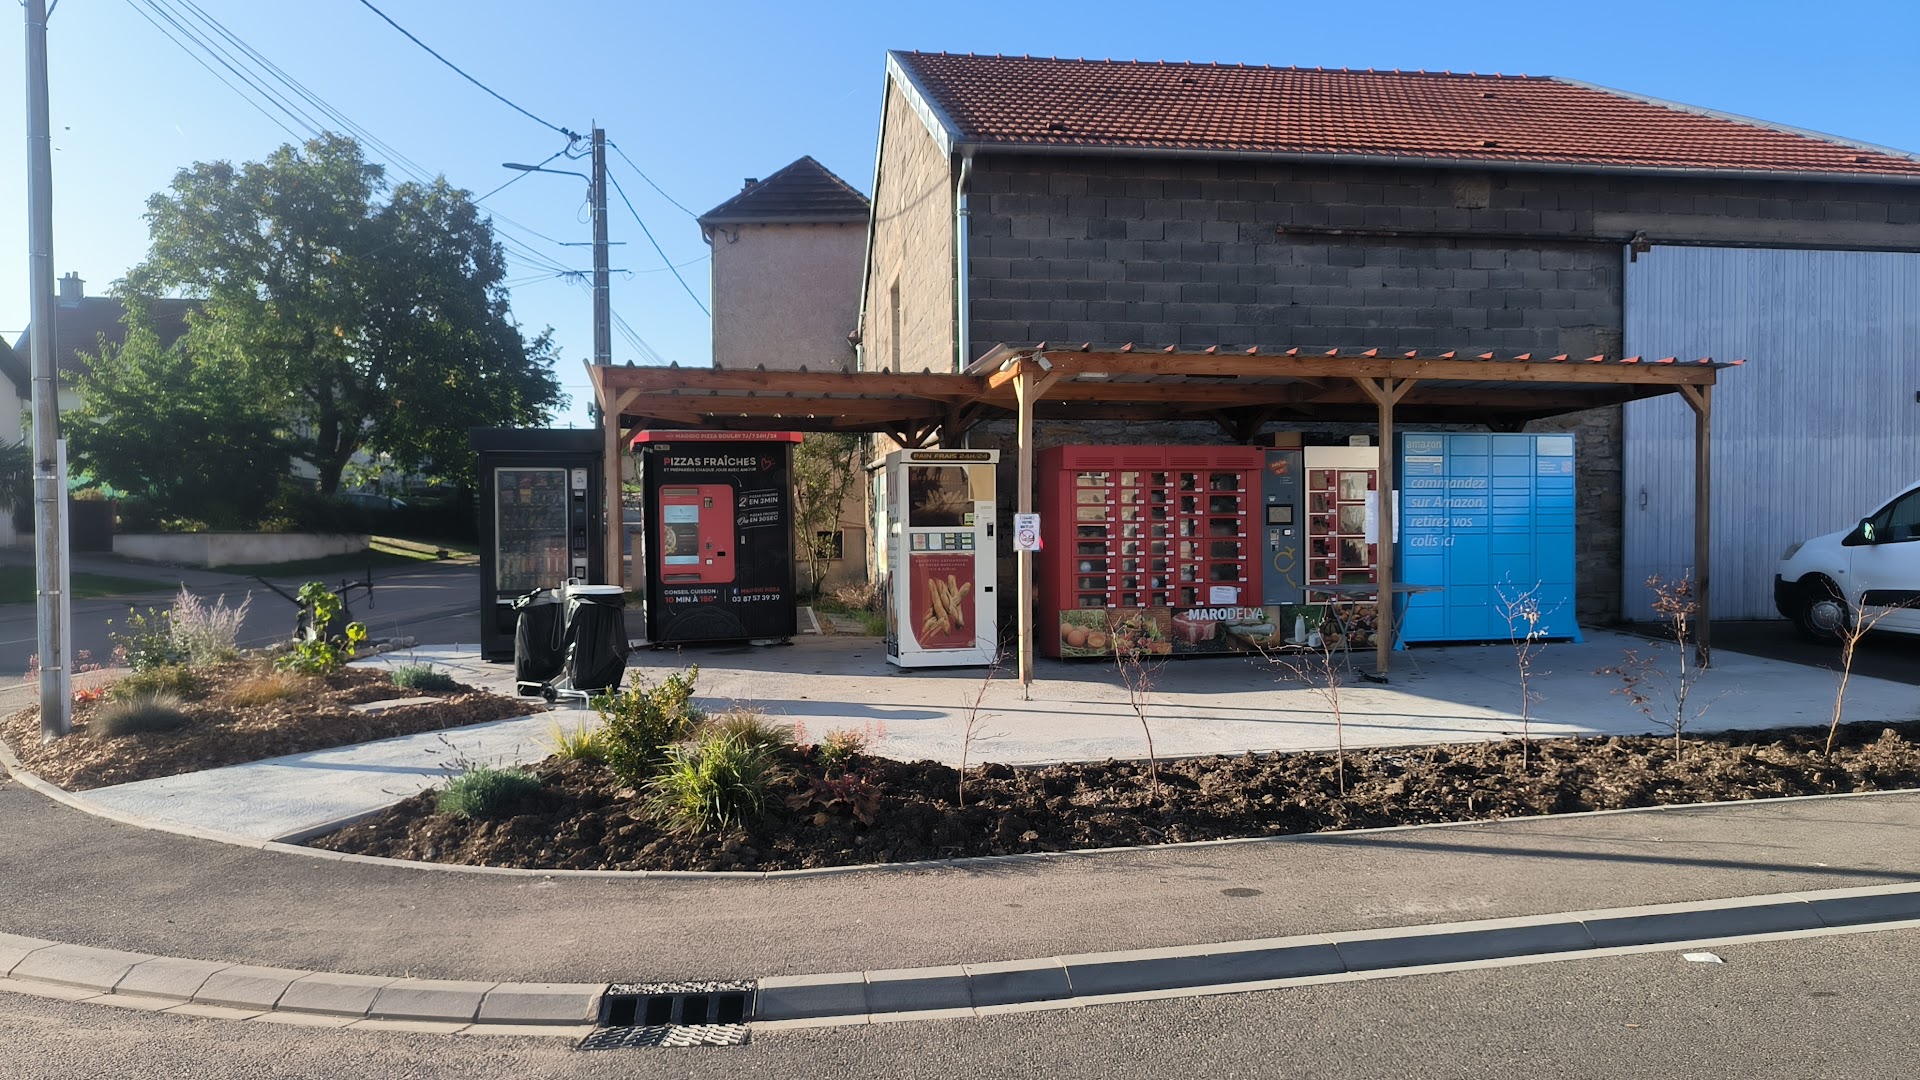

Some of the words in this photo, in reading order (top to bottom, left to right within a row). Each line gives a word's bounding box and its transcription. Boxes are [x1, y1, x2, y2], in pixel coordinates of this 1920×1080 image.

[664, 457, 700, 466] PIZZAS
[704, 454, 756, 466] FRAÎCHES
[1411, 477, 1485, 488] commandez
[1411, 498, 1431, 507] sur
[1433, 496, 1485, 510] Amazon,
[1411, 515, 1449, 527] retirez
[1453, 518, 1472, 527] vos
[1410, 534, 1438, 546] colis
[1441, 534, 1456, 546] ici
[692, 594, 698, 603] À
[1188, 607, 1264, 620] MARODELYA
